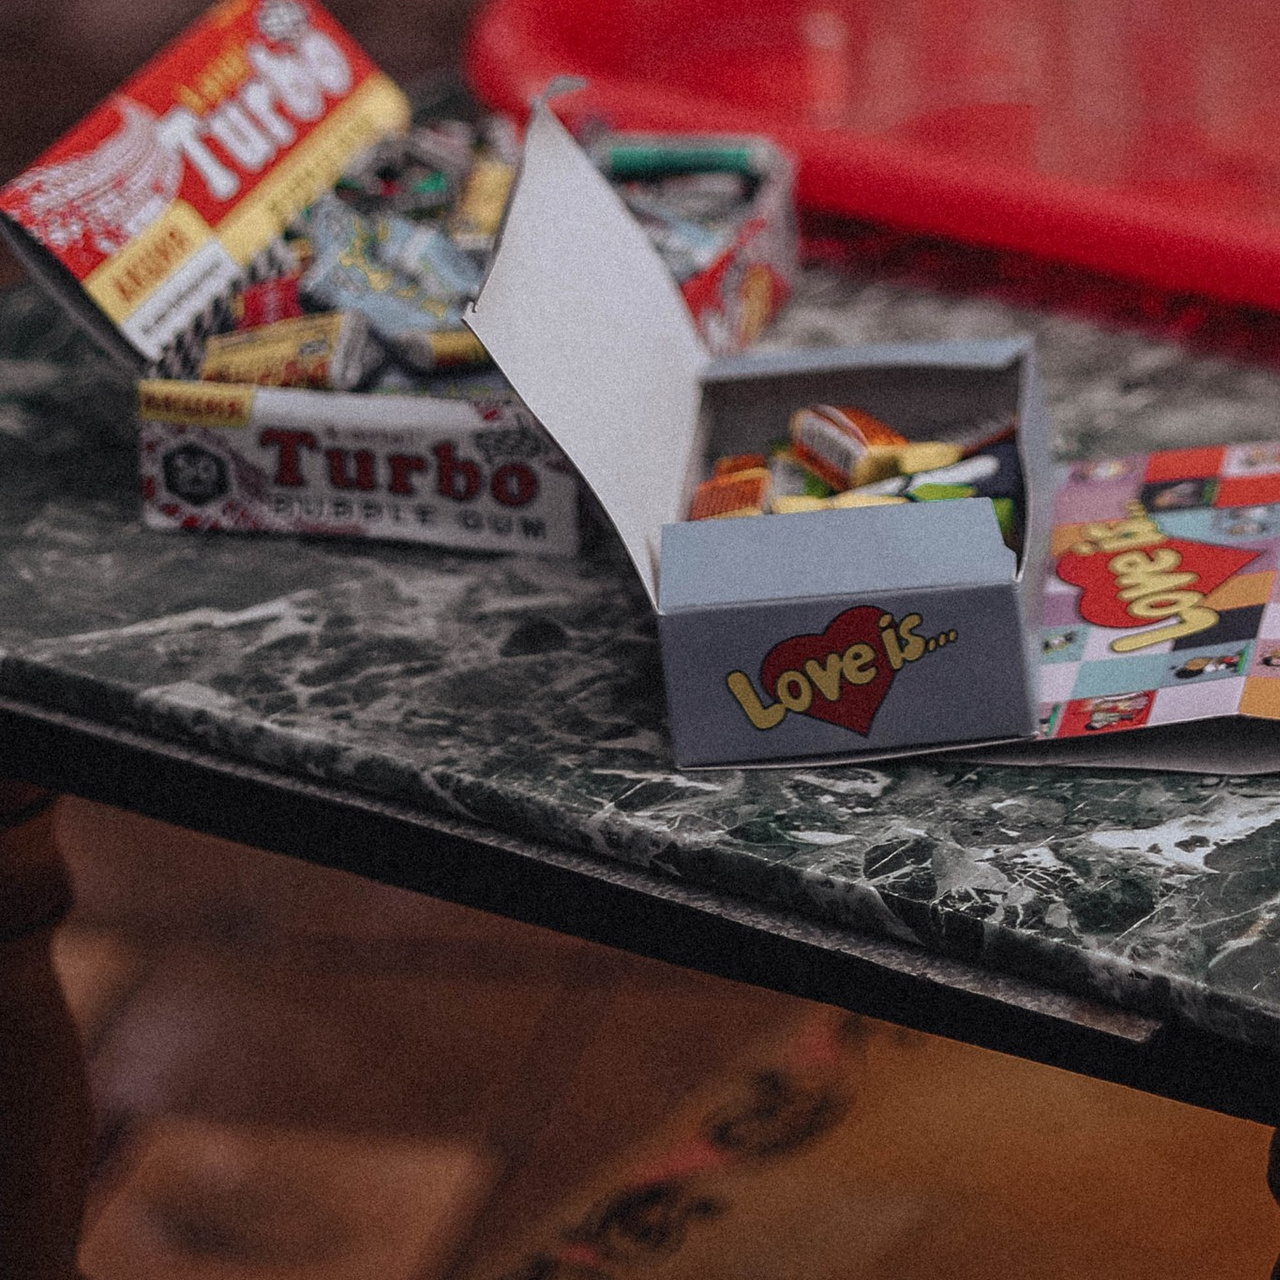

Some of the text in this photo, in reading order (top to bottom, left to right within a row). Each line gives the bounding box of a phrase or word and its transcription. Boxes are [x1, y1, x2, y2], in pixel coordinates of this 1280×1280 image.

[155, 30, 355, 202] Turbo
[258, 426, 539, 508] Turbo
[457, 507, 548, 542] GUM
[1107, 546, 1221, 654] Love
[726, 611, 959, 731] Love is...
